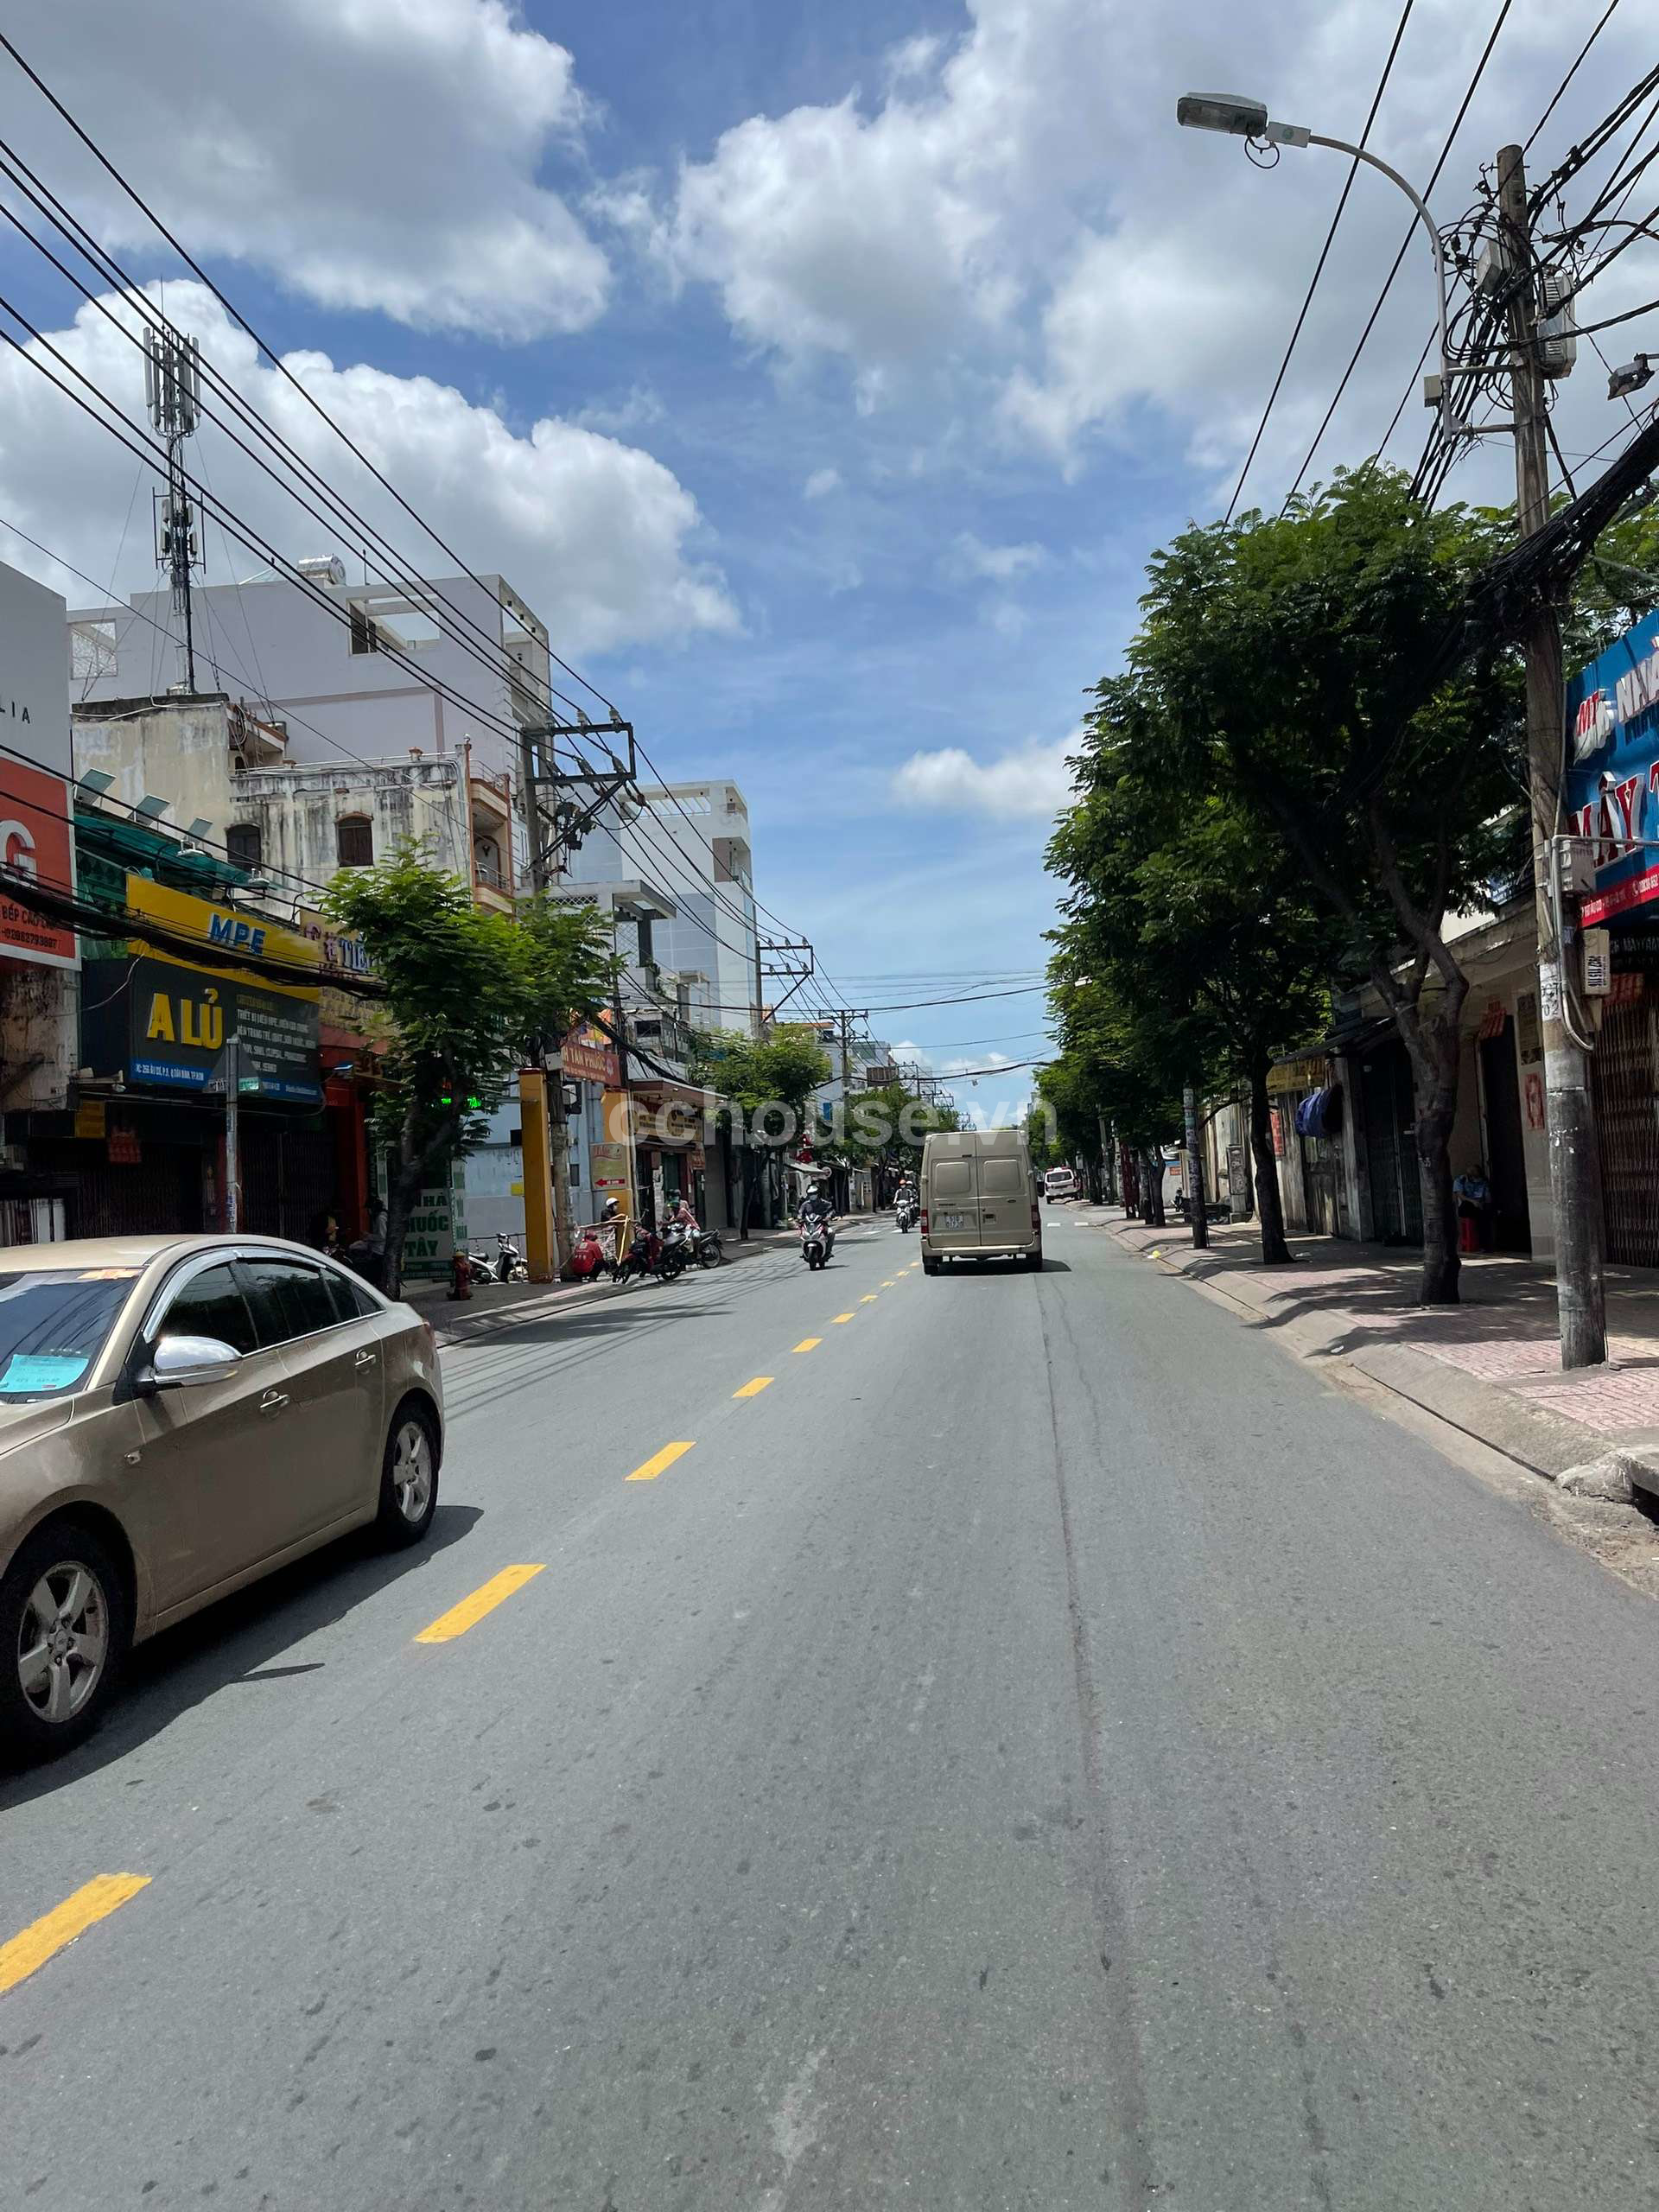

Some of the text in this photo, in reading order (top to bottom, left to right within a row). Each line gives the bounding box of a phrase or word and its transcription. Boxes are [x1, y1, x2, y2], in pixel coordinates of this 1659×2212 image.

[0, 701, 30, 724] IA
[208, 912, 267, 956] MPE
[408, 1209, 449, 1234] HUỐC
[404, 1236, 439, 1257] TÂY
